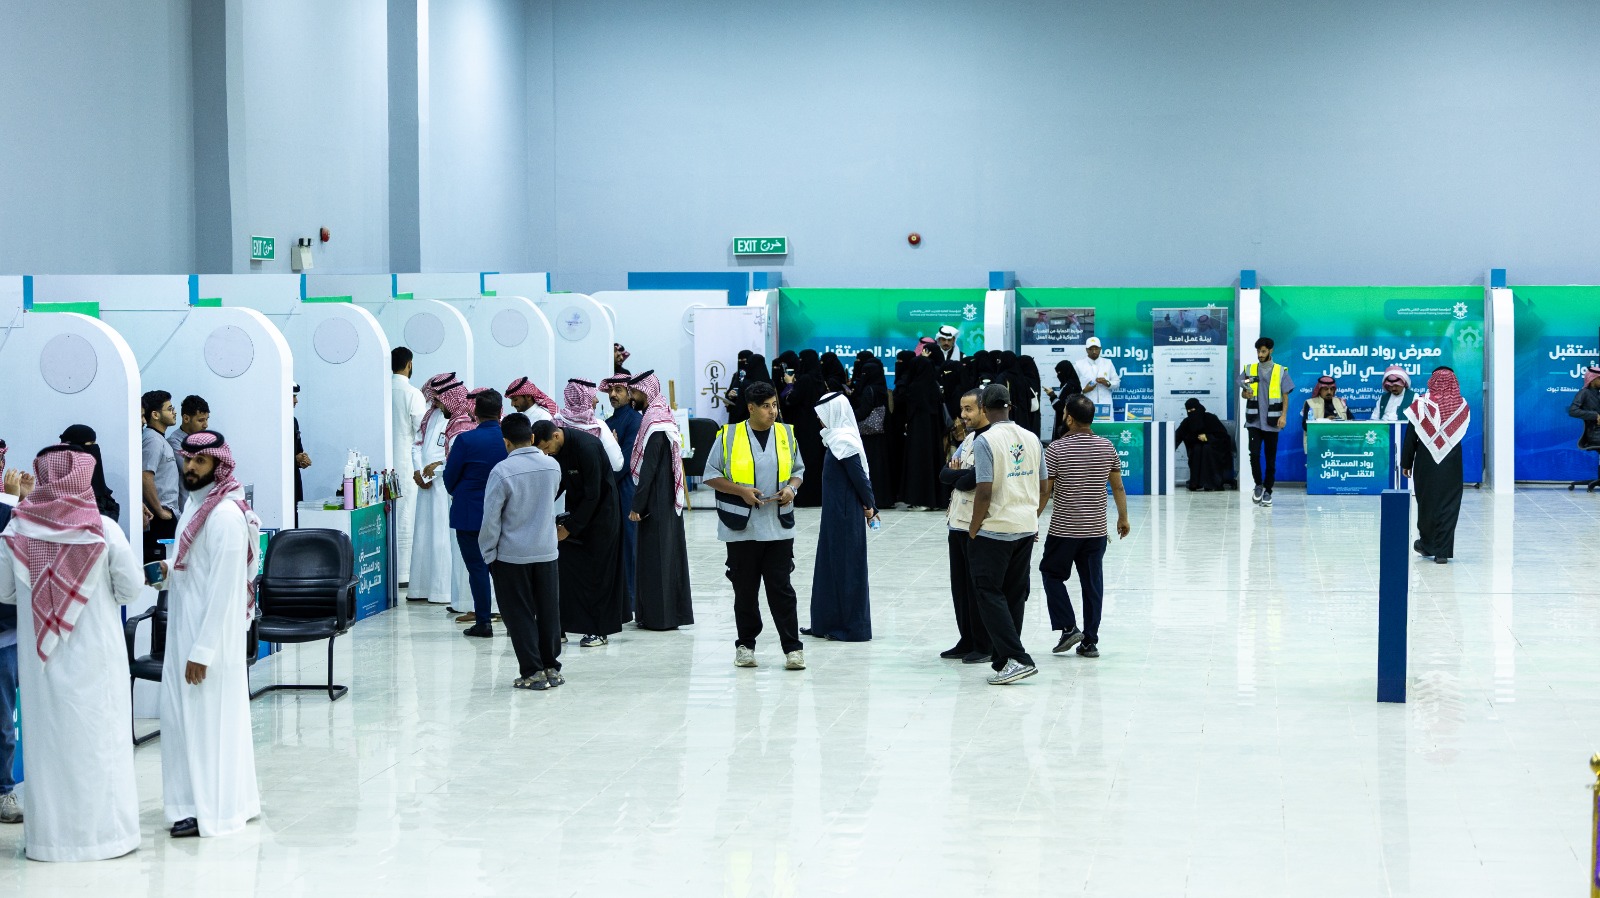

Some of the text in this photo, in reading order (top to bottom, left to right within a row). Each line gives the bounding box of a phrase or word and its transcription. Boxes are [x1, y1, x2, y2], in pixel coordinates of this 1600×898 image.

[253, 240, 262, 256] EXIT
[263, 241, 273, 256] خروج
[738, 240, 757, 252] EXIT
[760, 239, 782, 251] خروج
[1124, 346, 1148, 361] رواد
[1302, 344, 1442, 361] معرض رواد المستقبل
[1322, 360, 1356, 378] الأول
[1321, 450, 1374, 458] معرض
[1322, 460, 1374, 470] رواد المستقبل
[1320, 469, 1374, 480] التقني الأول
